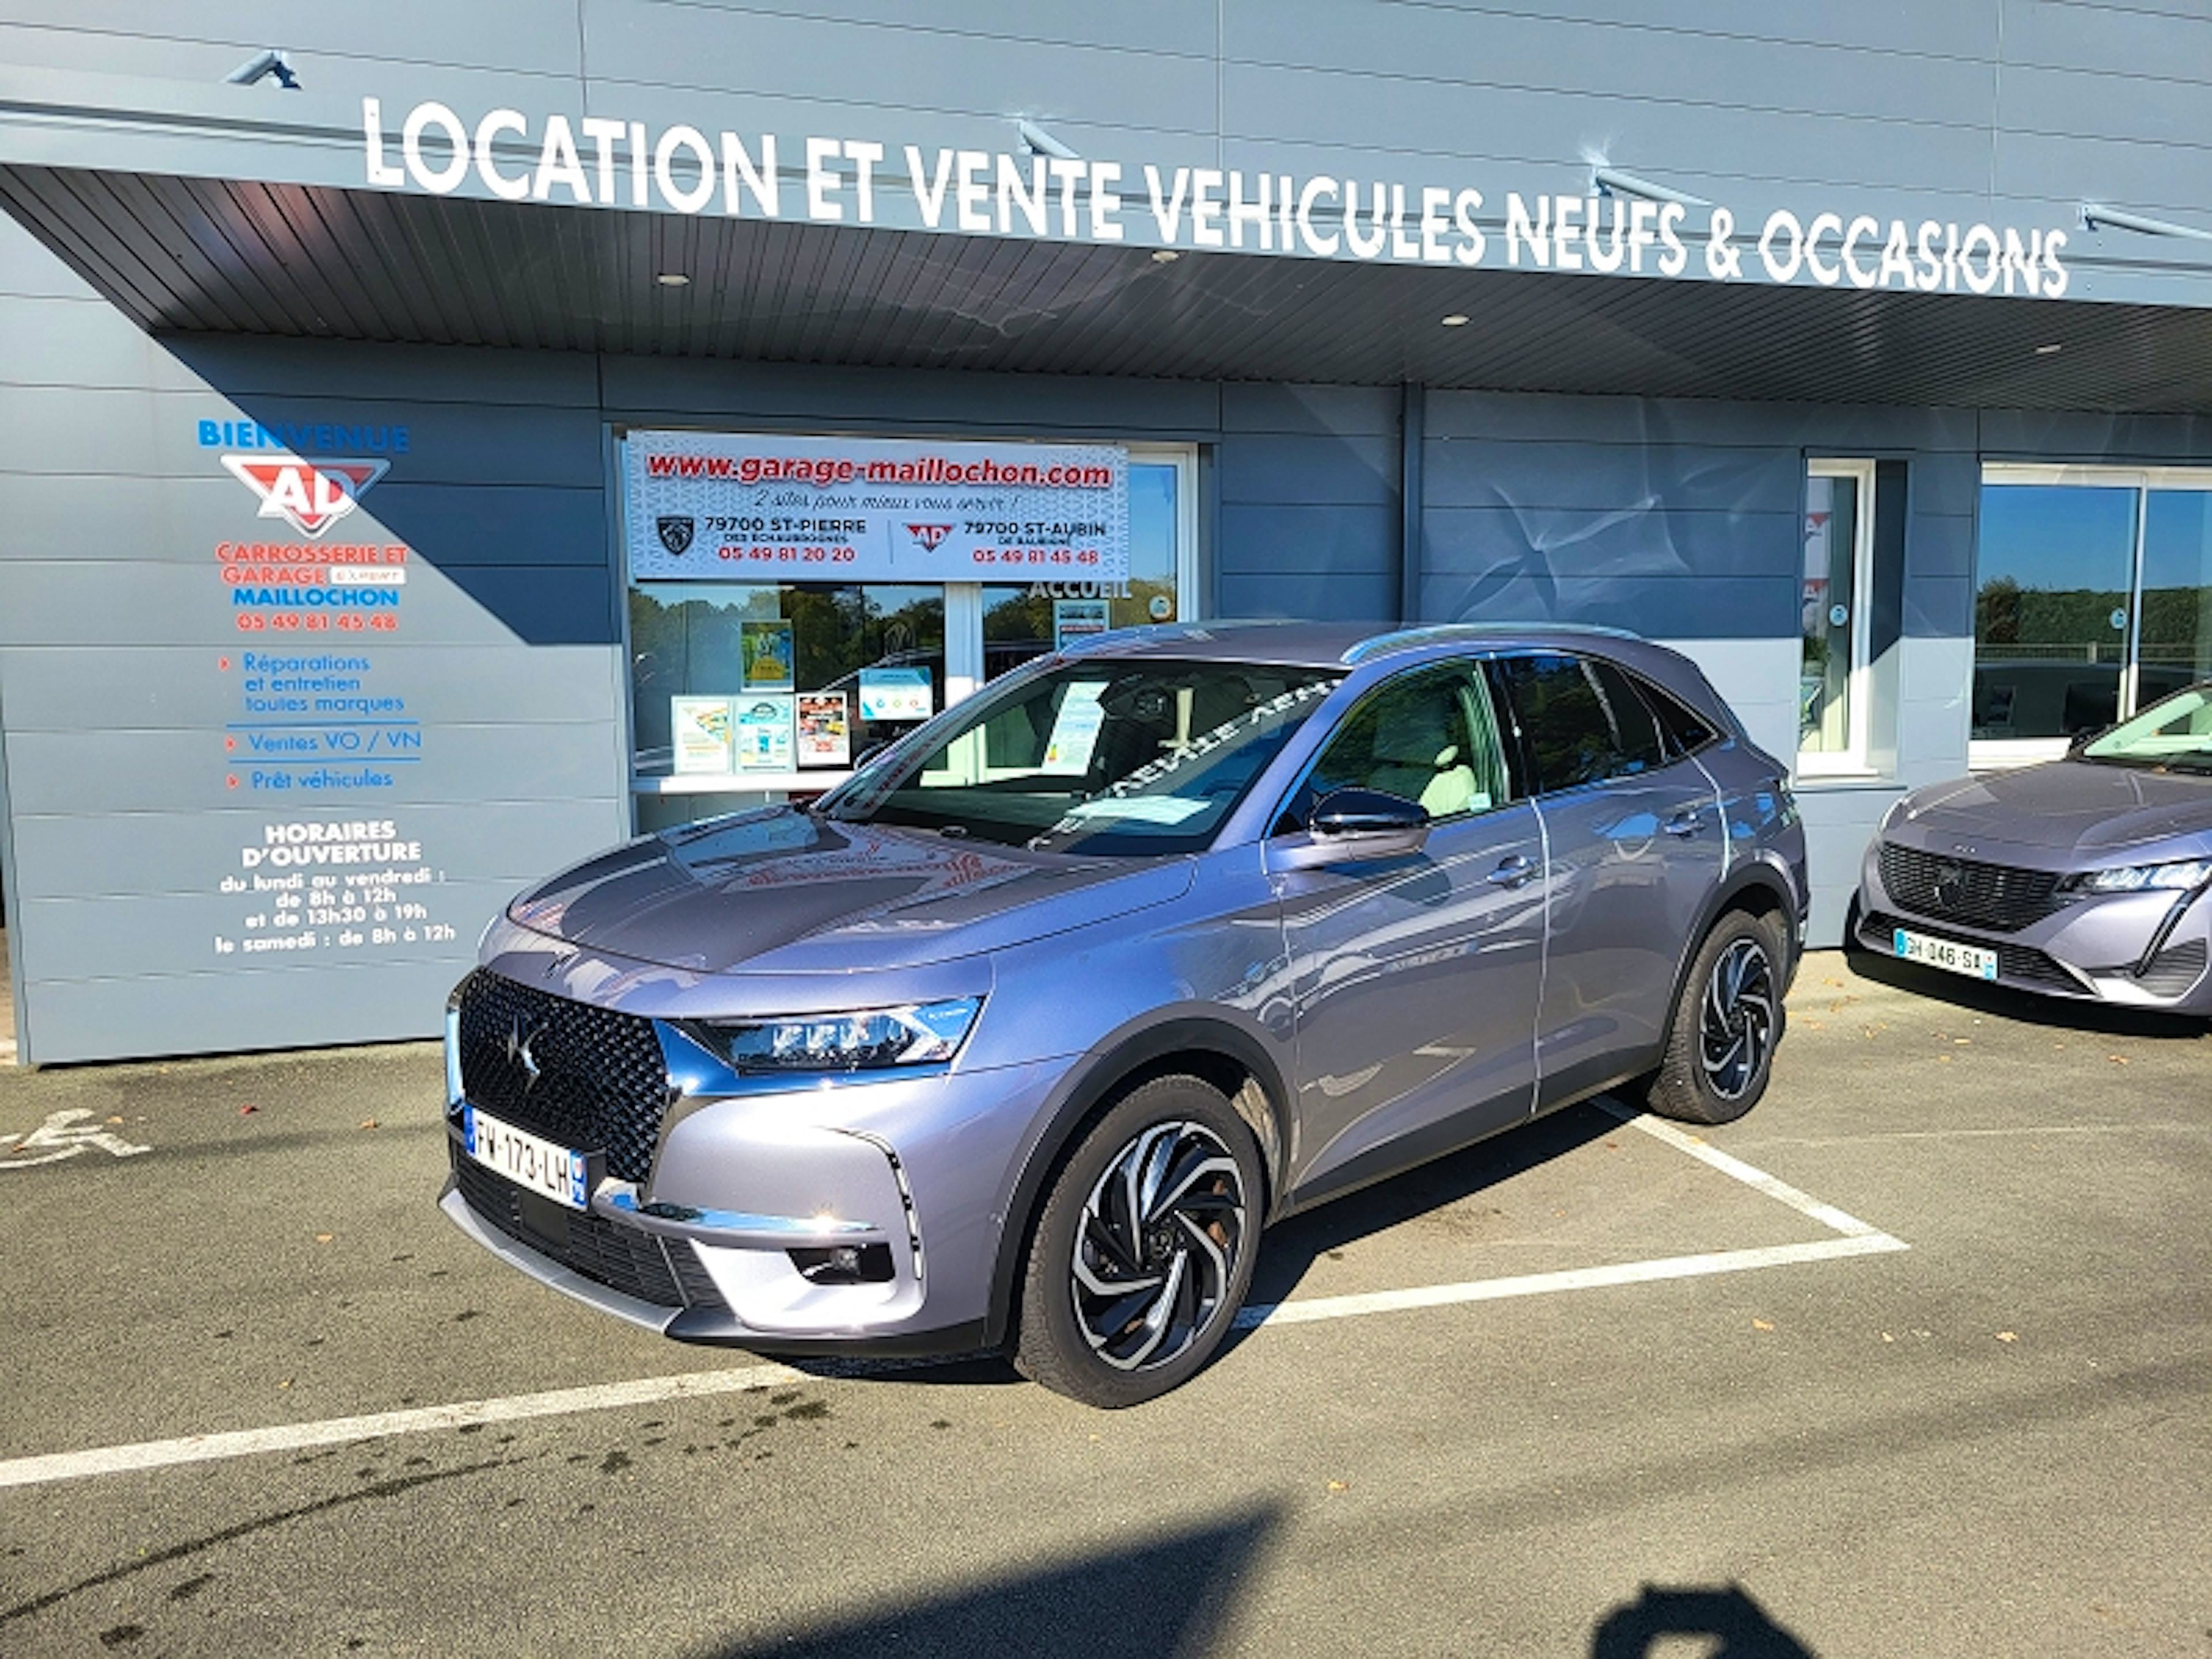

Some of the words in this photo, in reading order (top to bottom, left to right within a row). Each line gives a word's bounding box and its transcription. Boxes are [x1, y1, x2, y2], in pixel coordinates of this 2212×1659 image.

[363, 96, 779, 218] LOCATION
[807, 137, 883, 222] ET
[904, 145, 1124, 240] VENTE
[1144, 164, 1484, 266] VEHICULES
[1505, 192, 1687, 276] NEUFS
[1705, 206, 1744, 281] &
[1758, 209, 2069, 298] OCCASIONS
[199, 420, 410, 454] BIENVENUE
[648, 454, 1112, 487] www.garage-maillochon.com
[257, 467, 355, 517] AD
[755, 489, 769, 506] 2
[813, 494, 857, 511] pour
[705, 517, 764, 531] 79700
[770, 518, 866, 533] ST-PIERRE
[964, 522, 1019, 535] 79700
[1025, 522, 1106, 536] ST-AUBIN
[216, 544, 377, 564] CARROSSERIE
[385, 546, 410, 564] ET
[718, 547, 743, 560] 05
[749, 547, 772, 561] 49
[779, 547, 797, 561] 81
[801, 547, 825, 562] 20
[831, 547, 855, 562] 20
[972, 550, 995, 563] 05
[1001, 550, 1023, 564] 49
[1028, 550, 1045, 564] 81
[1050, 550, 1071, 565] 45
[1076, 551, 1099, 565] 48
[221, 567, 325, 586] GARAGE
[233, 588, 399, 607] MAILLOCHON
[1028, 581, 1132, 599] ACCUEIL
[237, 613, 266, 631] 05
[271, 613, 299, 631] 49
[304, 613, 329, 631] 81
[336, 613, 363, 630] 45
[369, 613, 398, 630] 48
[243, 652, 371, 676] Réparations
[245, 677, 264, 692] et
[271, 675, 361, 692] entretien
[245, 696, 308, 713] toutes
[315, 696, 404, 715] marques
[249, 733, 319, 752] Ventes
[323, 732, 360, 749] VO
[387, 730, 421, 748] VN
[251, 769, 293, 790] Prêt
[297, 769, 394, 788] véhicules
[264, 820, 397, 844] HORAIRES
[241, 841, 422, 868] D'OUVERTURE
[219, 875, 247, 893] du
[253, 873, 304, 891] lundi
[311, 874, 337, 889] au
[344, 867, 433, 887] vendredi
[275, 893, 302, 910] de
[309, 890, 335, 907] 8h
[342, 890, 355, 906] à
[363, 888, 397, 904] 12h
[245, 912, 266, 929] et
[272, 910, 300, 927] de
[306, 908, 366, 926] 13h30
[373, 906, 388, 922] à
[393, 904, 427, 920] 19h
[214, 936, 233, 955] le
[243, 930, 317, 952] samedi
[339, 929, 364, 947] de
[372, 927, 397, 945] 8h
[404, 927, 418, 942] à
[423, 924, 457, 942] 12h
[477, 1120, 570, 1196] FW-173-LH
